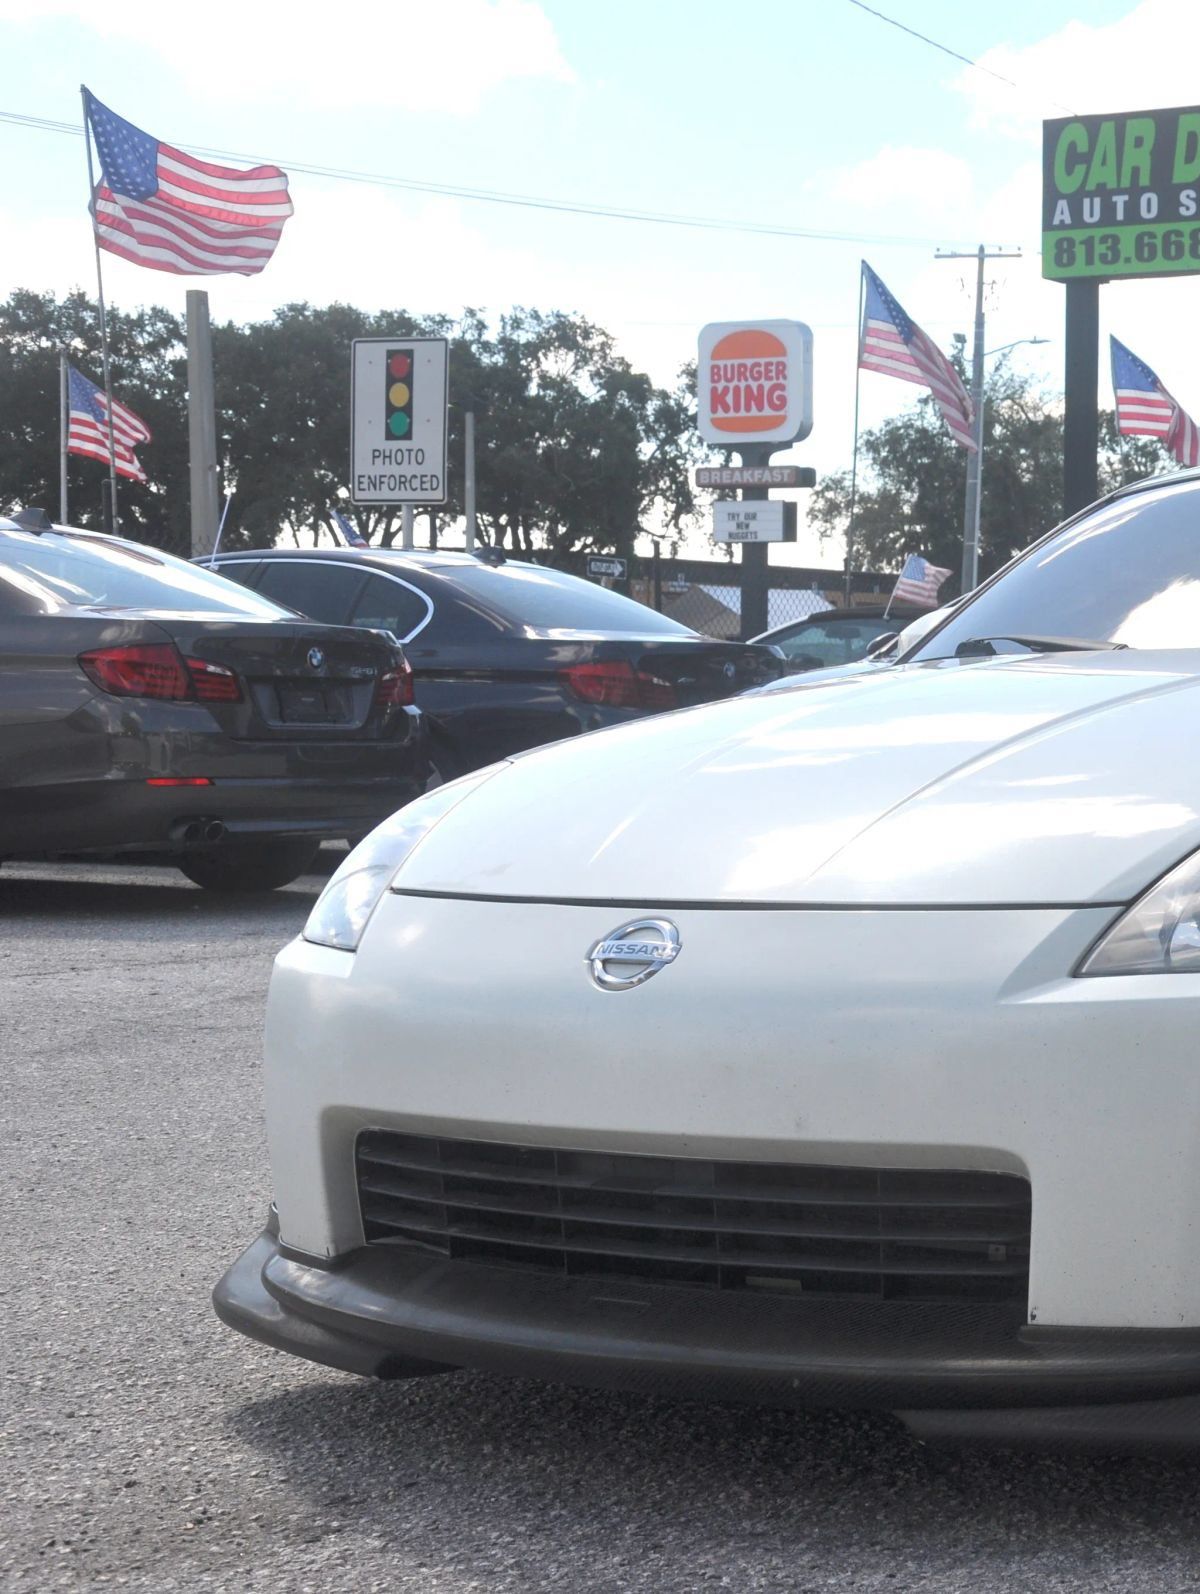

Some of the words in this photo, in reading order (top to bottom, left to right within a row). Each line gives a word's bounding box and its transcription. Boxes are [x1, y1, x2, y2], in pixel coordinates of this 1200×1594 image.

[1053, 116, 1156, 195] CAR
[1052, 191, 1158, 226] AUTO
[710, 360, 788, 384] BURGER
[710, 382, 788, 415] KING
[371, 448, 425, 466] PHOTO
[357, 473, 440, 492] ENFORCED
[700, 468, 791, 485] BREAKFAST
[727, 512, 740, 521] TRY
[743, 512, 758, 521] OUR
[735, 521, 750, 530] NEW
[728, 531, 758, 540] NUGGETS
[597, 943, 667, 956] NISSAN
